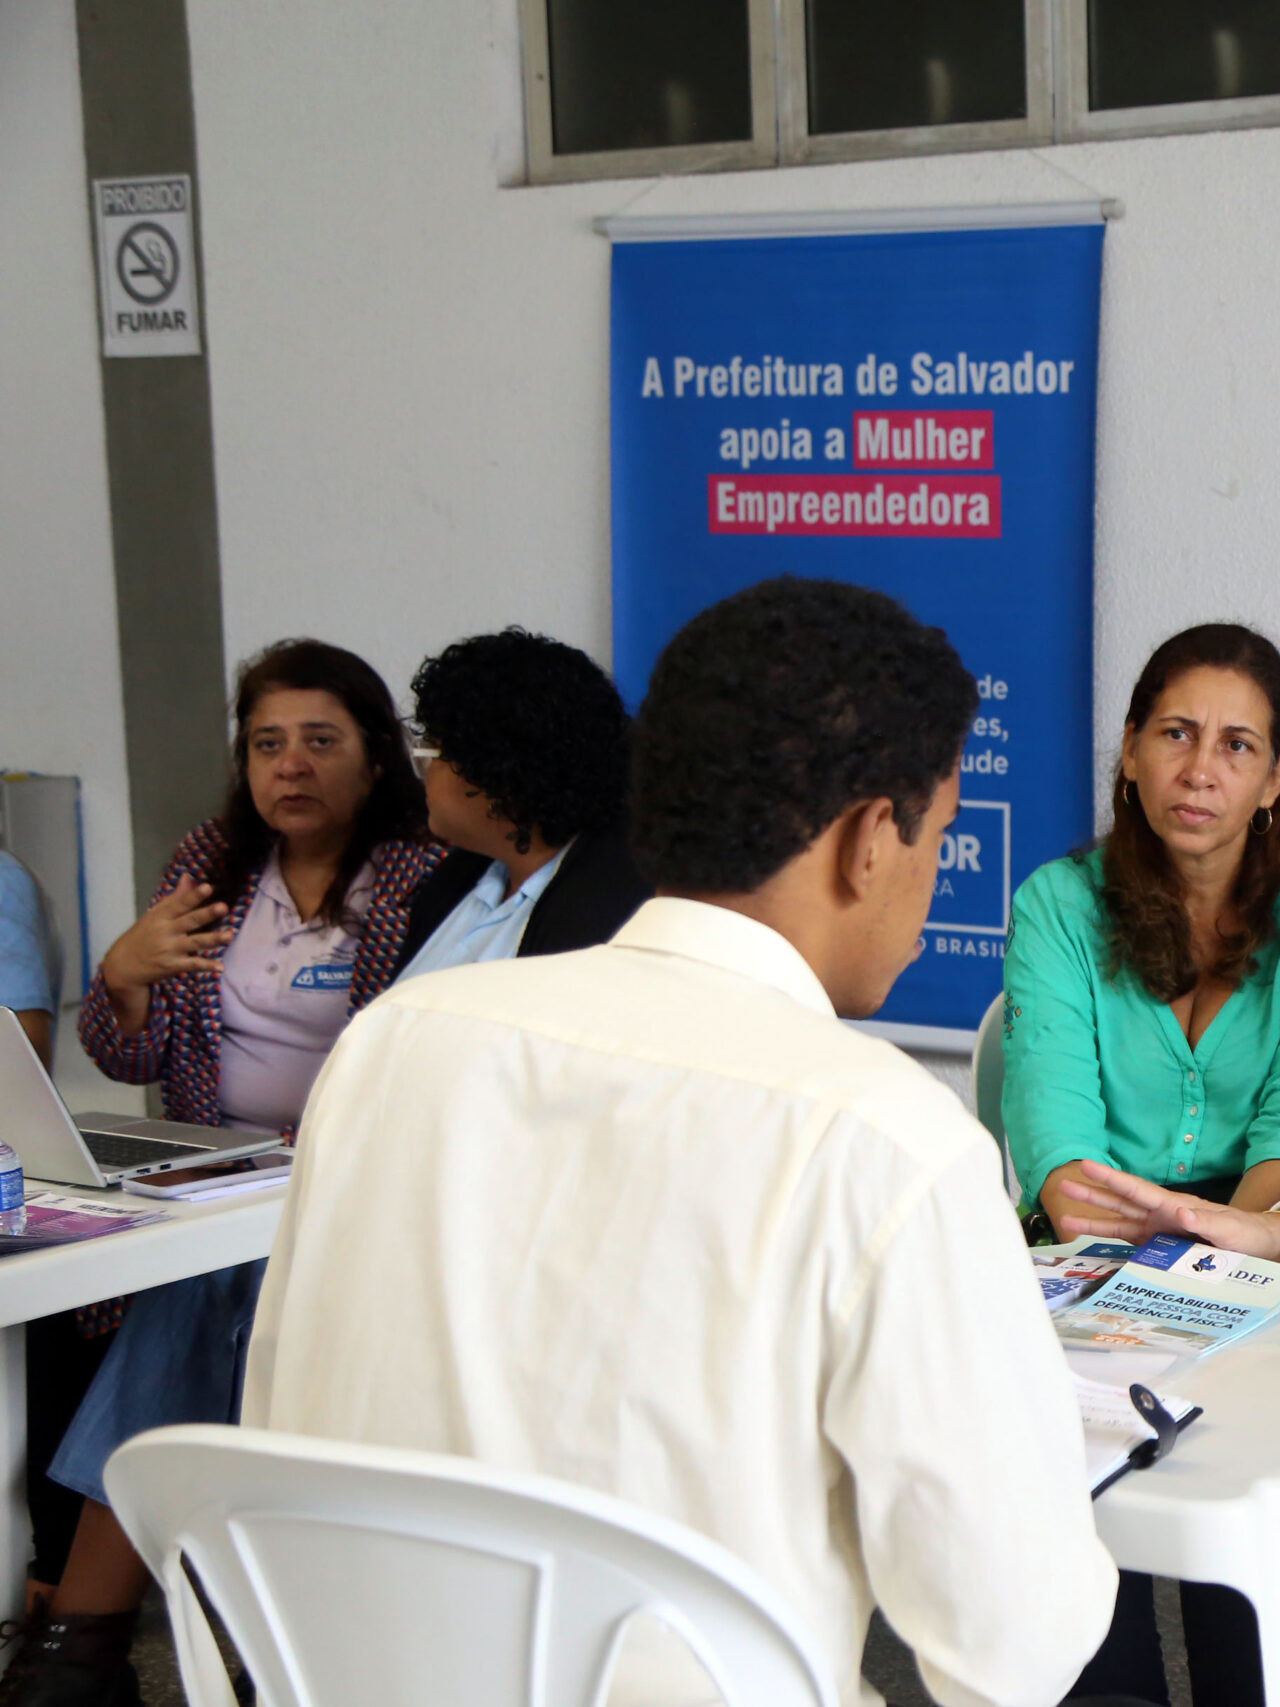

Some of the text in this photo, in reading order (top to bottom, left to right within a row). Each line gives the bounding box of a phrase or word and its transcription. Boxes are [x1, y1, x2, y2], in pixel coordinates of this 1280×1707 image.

[103, 182, 185, 214] PROIBIDO
[116, 310, 187, 333] FUMAR
[642, 352, 1074, 397] A Prefeitura de Salvador
[720, 418, 985, 468] apoia a Mulher
[716, 482, 990, 532] Empreendedora
[935, 937, 1005, 958] BRASIL
[1104, 1292, 1244, 1324] PARA PESSOA COM
[1114, 1282, 1251, 1316] EMPREGABILIDADE
